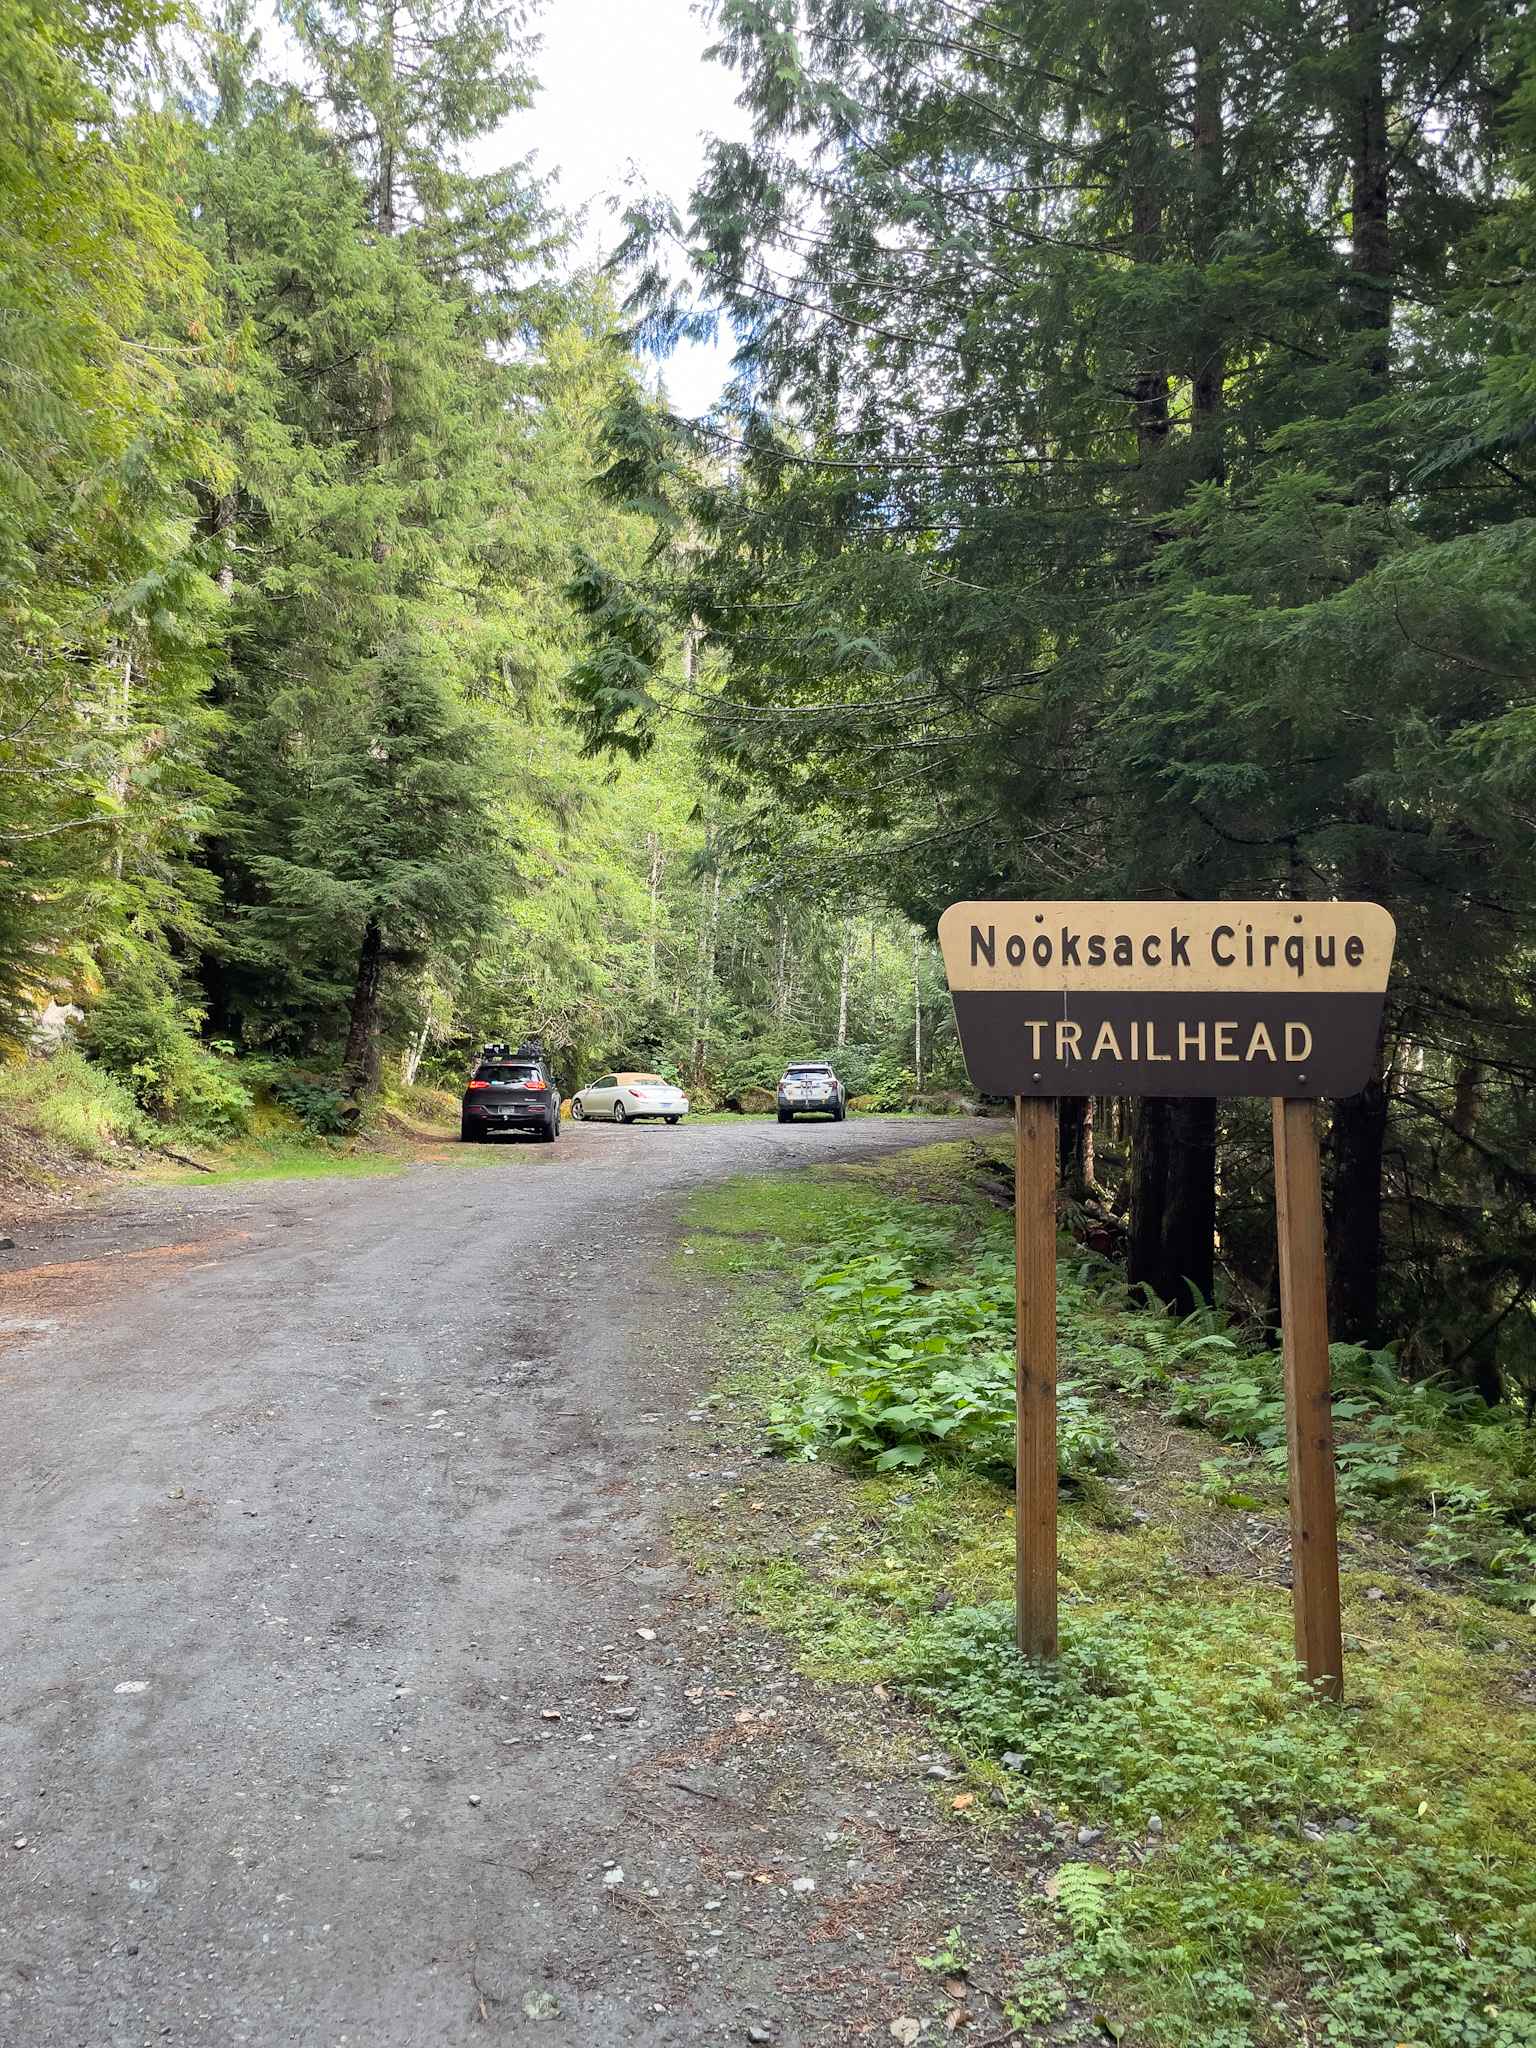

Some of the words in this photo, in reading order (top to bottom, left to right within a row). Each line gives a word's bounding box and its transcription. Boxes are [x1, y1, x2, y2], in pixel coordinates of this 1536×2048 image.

[970, 925, 1191, 967] Nooksack
[1211, 924, 1365, 976] Cirque
[1024, 1020, 1314, 1062] TRAILHEAD
